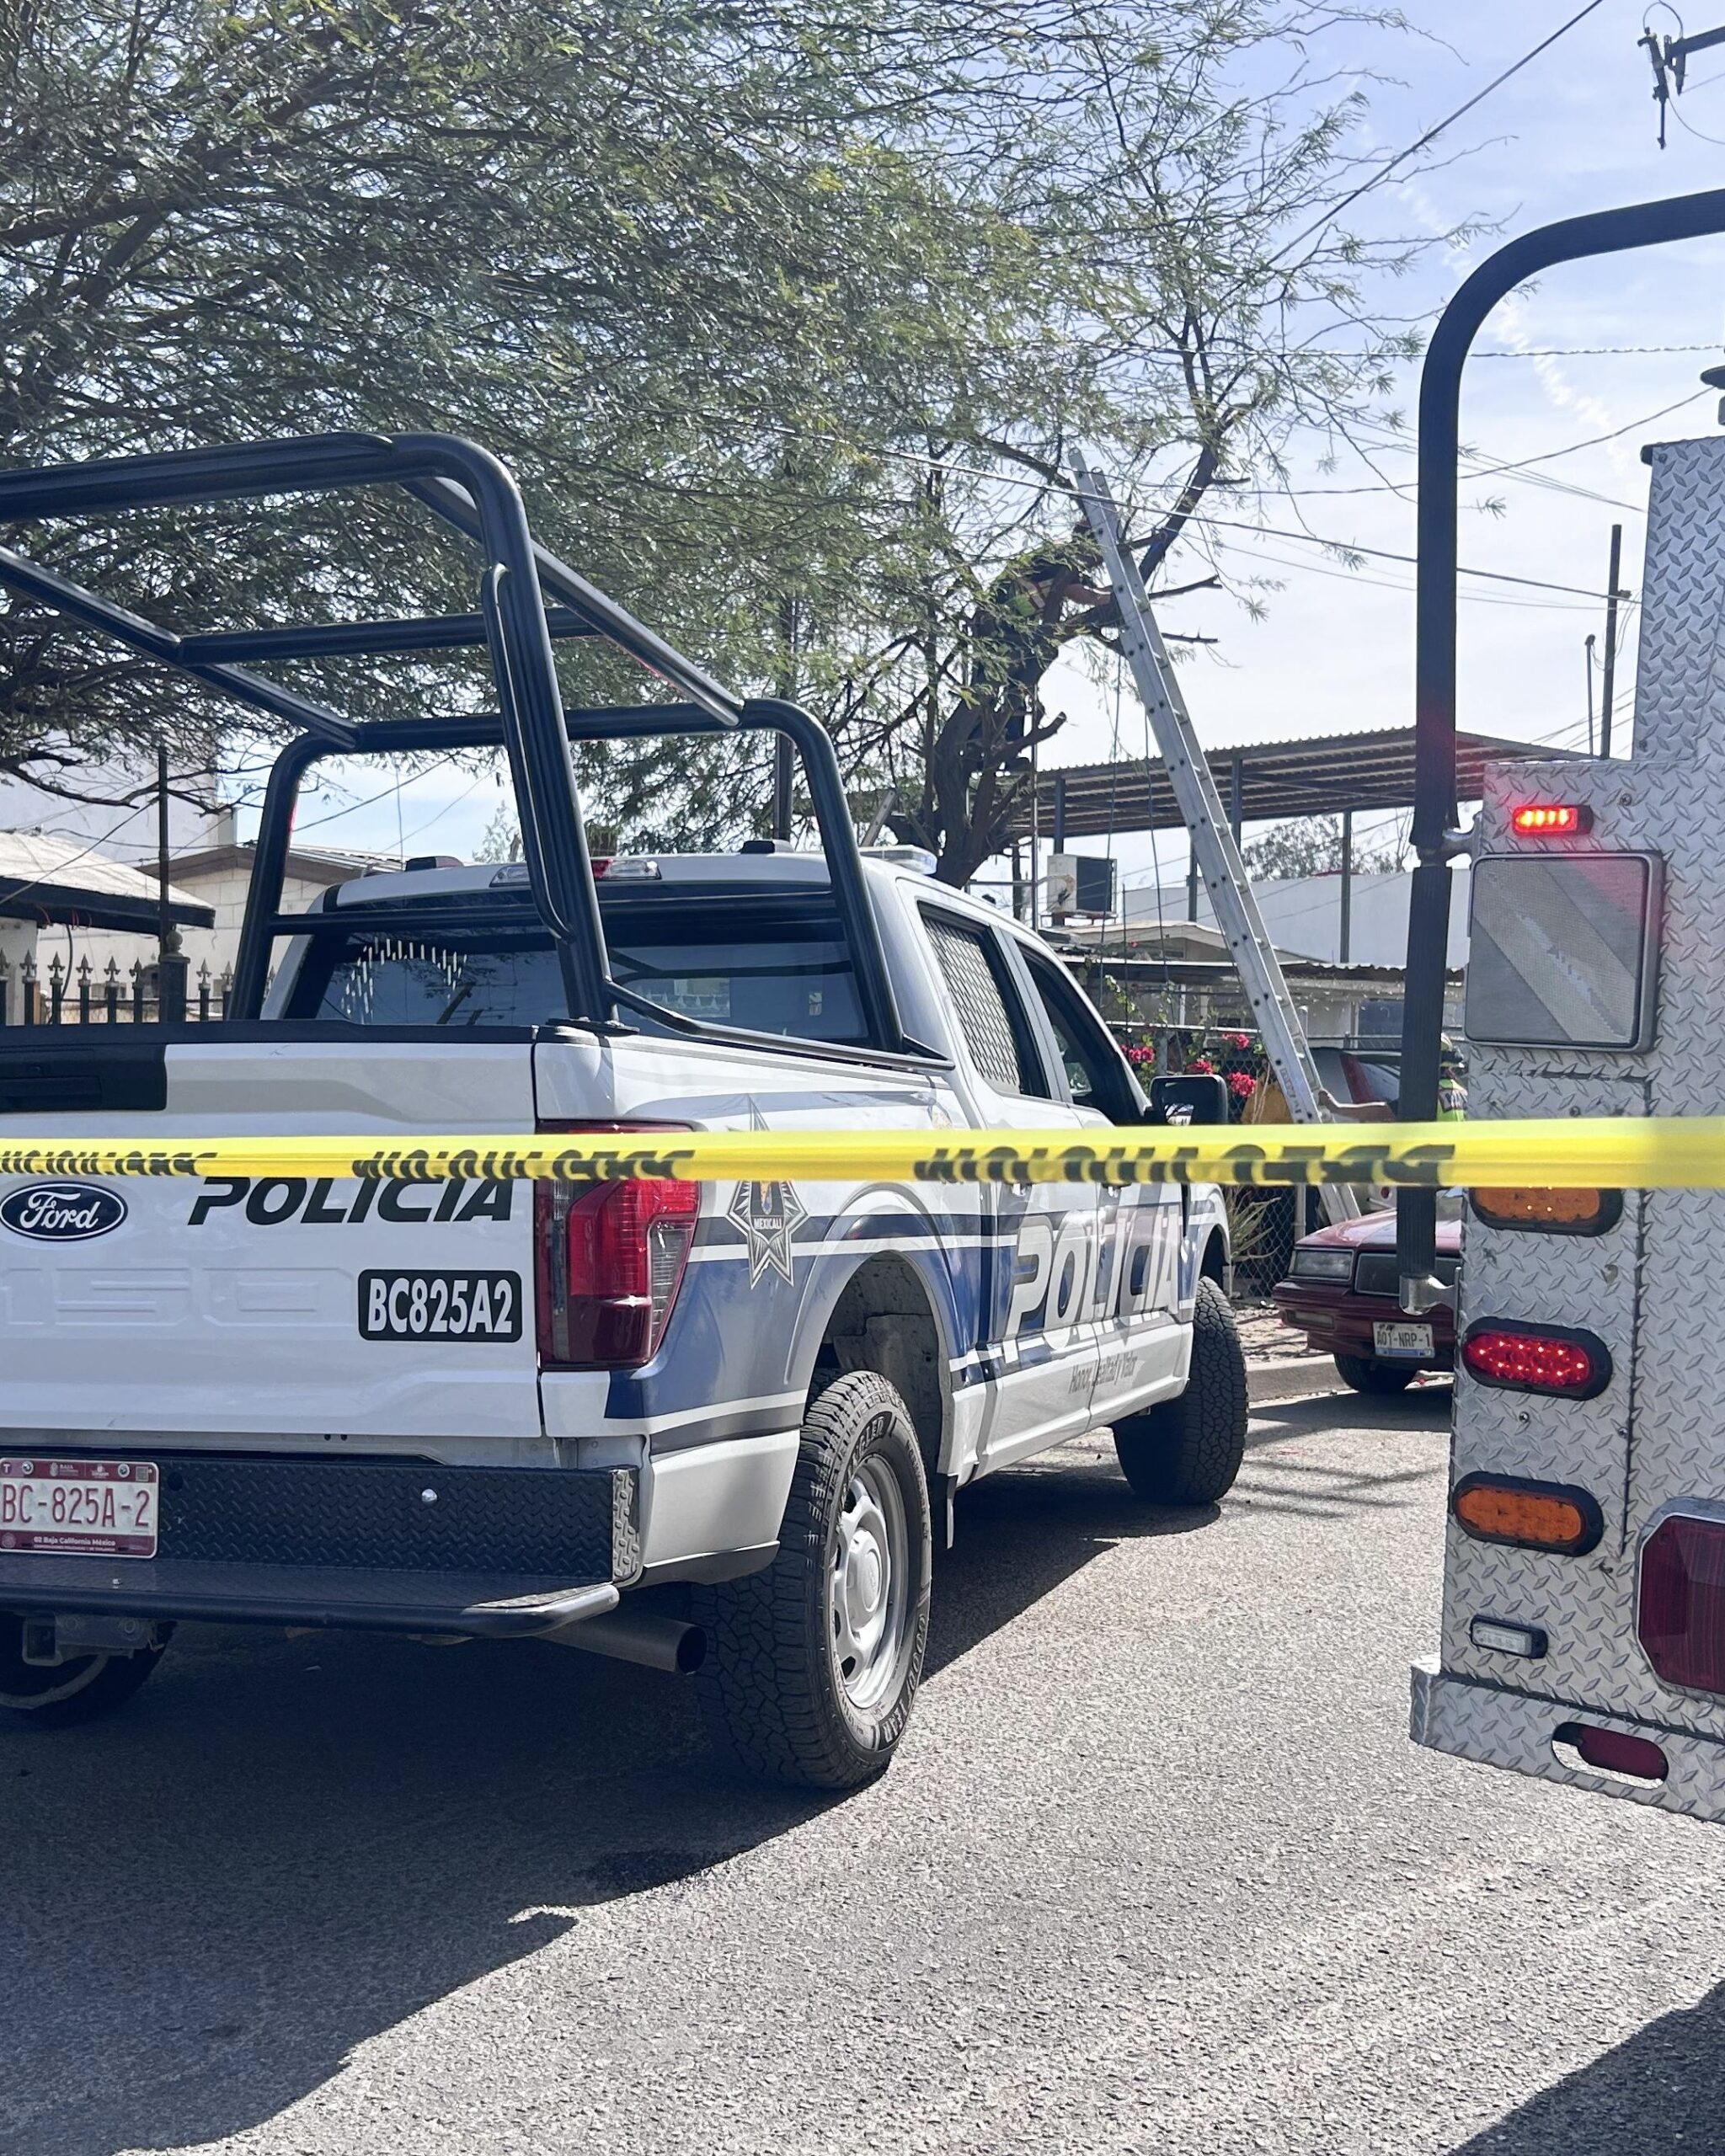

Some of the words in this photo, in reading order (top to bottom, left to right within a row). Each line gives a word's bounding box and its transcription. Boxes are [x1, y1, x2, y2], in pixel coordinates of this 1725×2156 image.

[19, 1190, 101, 1230] Ford
[187, 1176, 515, 1225] POLICIA
[753, 1217, 782, 1230] MEXICALI
[367, 1277, 514, 1335] BC825A2
[1002, 1204, 1179, 1364] POLICIA
[2, 1483, 150, 1528] BC-825A-2
[43, 1536, 58, 1545] Baja
[59, 1537, 91, 1545] California
[92, 1538, 116, 1546] México
